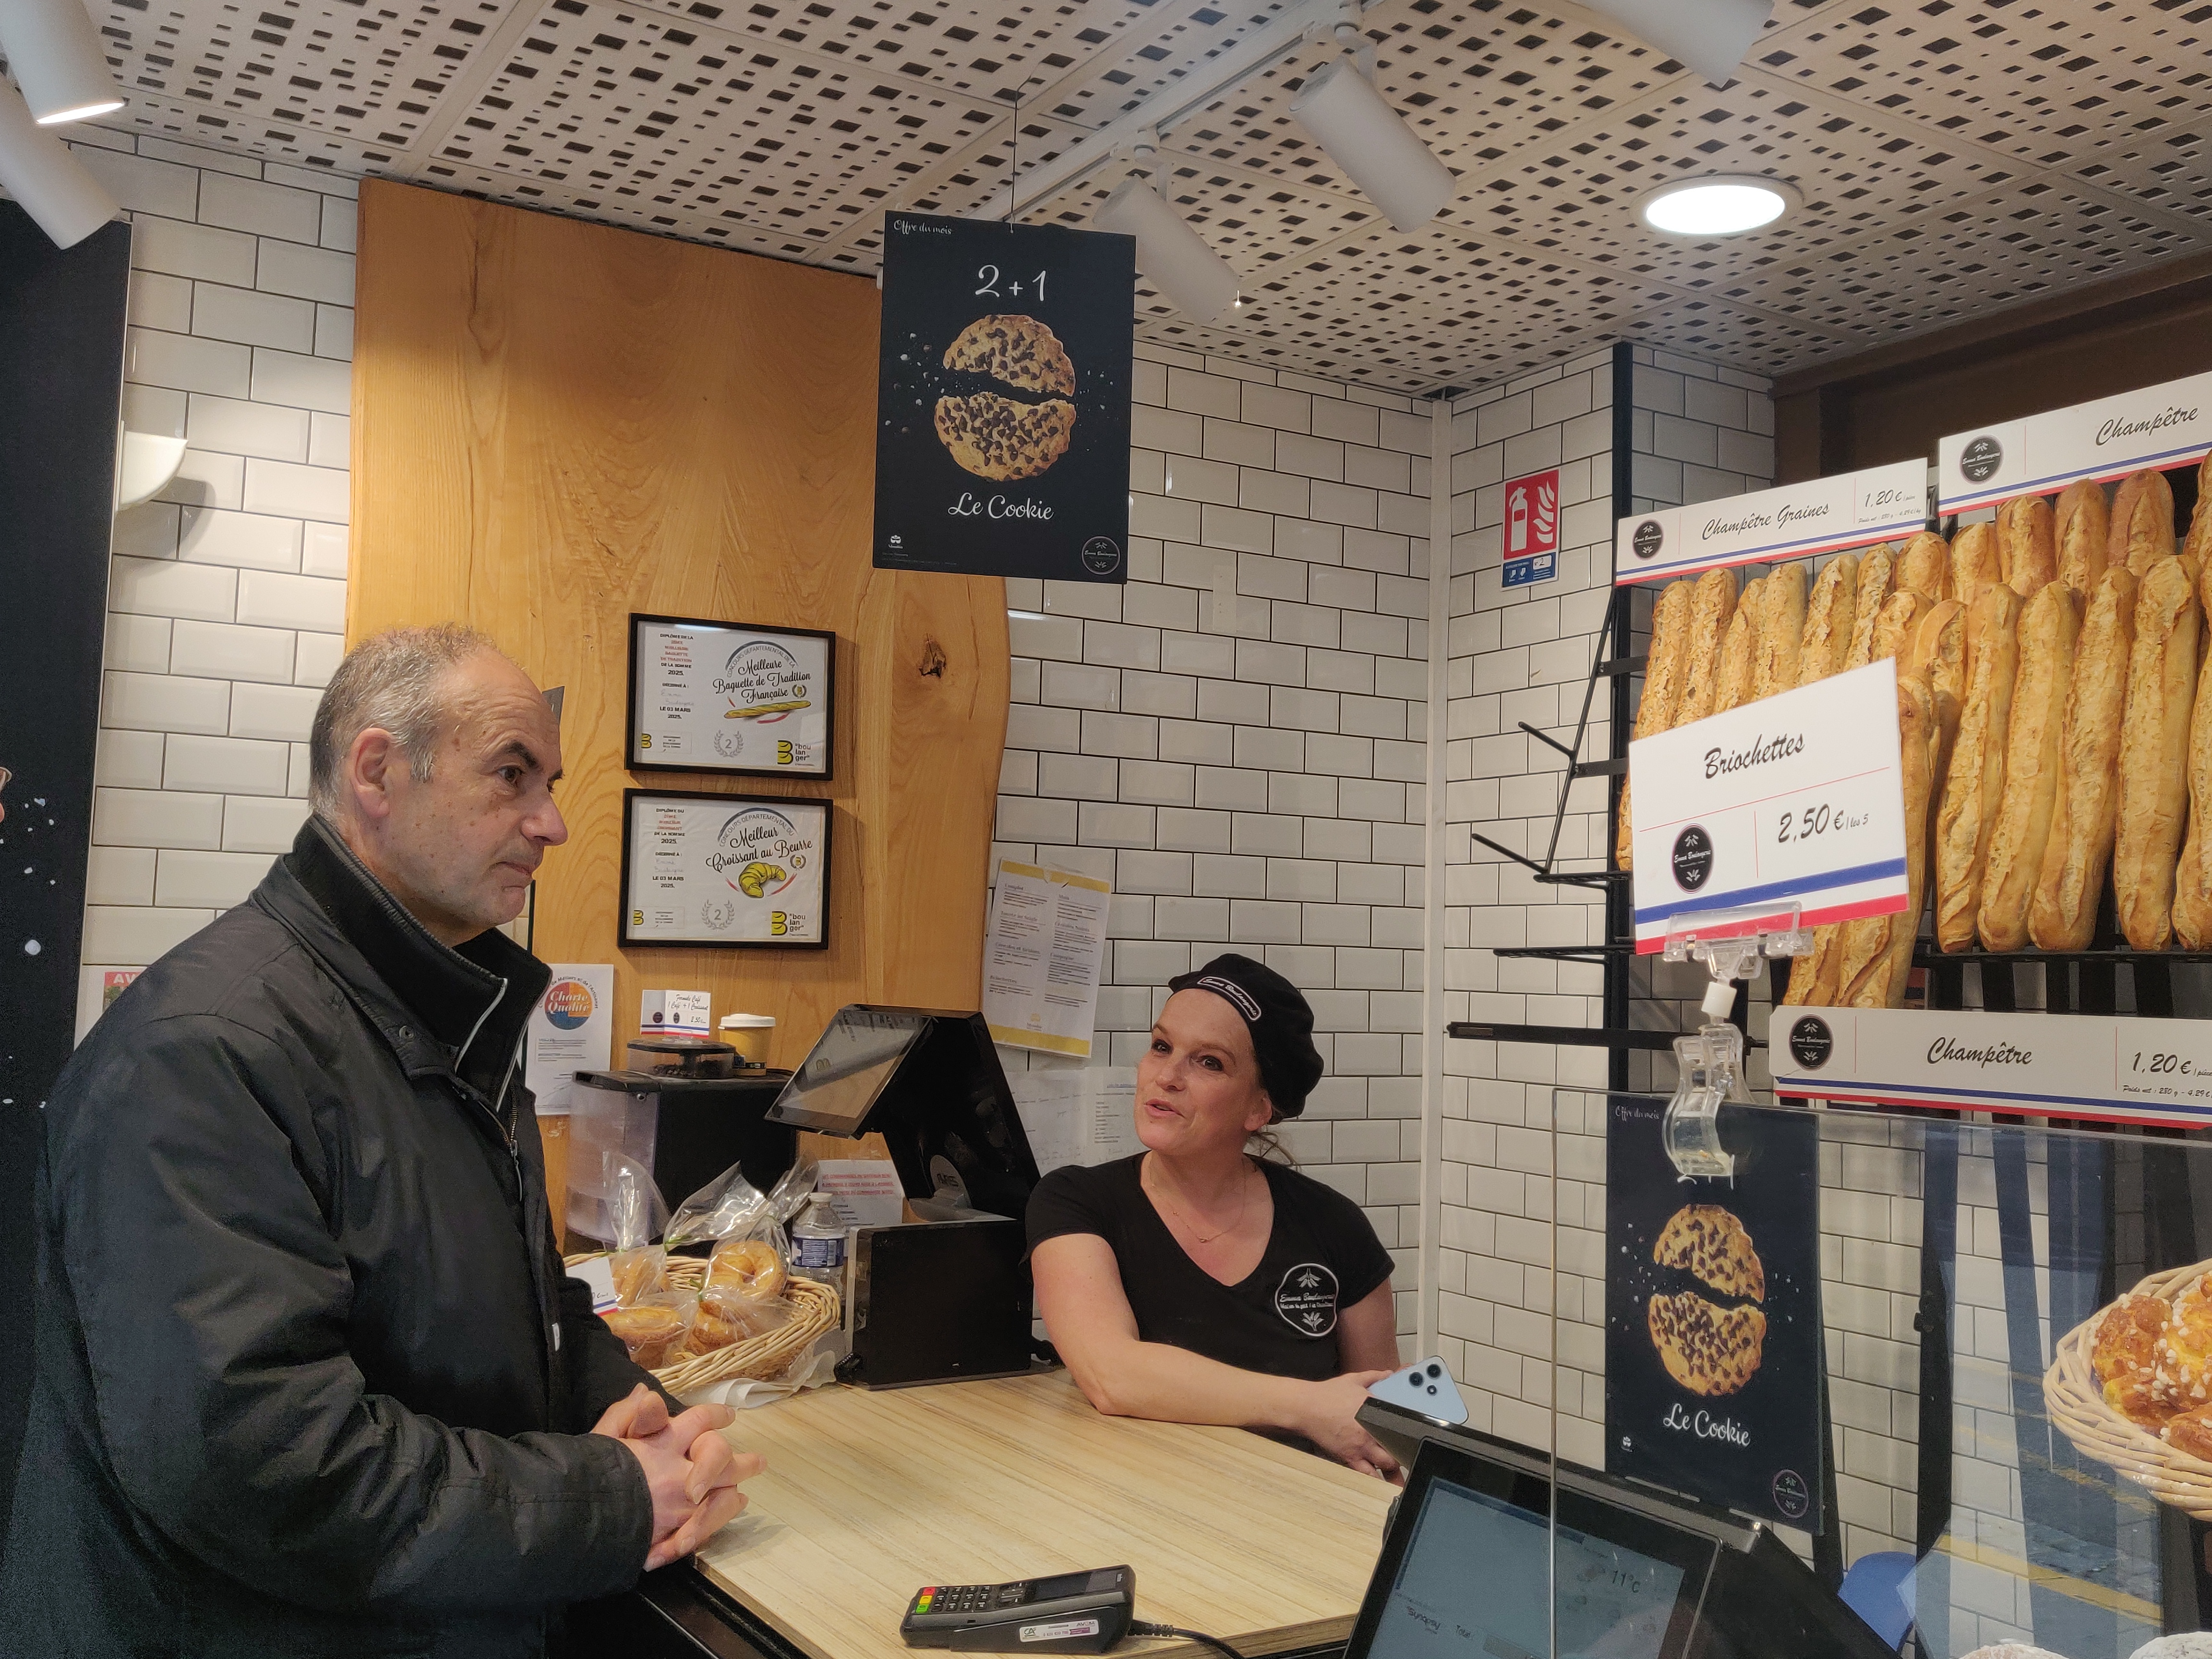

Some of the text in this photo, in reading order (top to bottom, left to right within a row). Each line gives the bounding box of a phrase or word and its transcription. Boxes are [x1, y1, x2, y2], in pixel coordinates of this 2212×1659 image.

[893, 219, 952, 234] Offre du mois
[975, 264, 1046, 301] 2 + 1
[2095, 406, 2198, 446] Champêtre
[948, 492, 1054, 520] Le Cookie
[1702, 504, 1829, 541] Champêtre Graines
[738, 659, 783, 676] Meilleure
[712, 670, 811, 694] Baguette de Tradition
[741, 688, 789, 704] Française
[725, 739, 732, 749] 2
[1704, 733, 1805, 779] Briochettes
[720, 821, 742, 847] CONCOURS
[786, 828, 795, 836] DU
[730, 826, 779, 848] Meilleur
[706, 840, 813, 873] Croissant au Beurre
[714, 910, 721, 921] 2
[548, 1001, 590, 1014] Qualité
[550, 991, 588, 1001] Charte
[1927, 1036, 2032, 1069] Champêtre
[1663, 1403, 1751, 1447] Le Cookie
